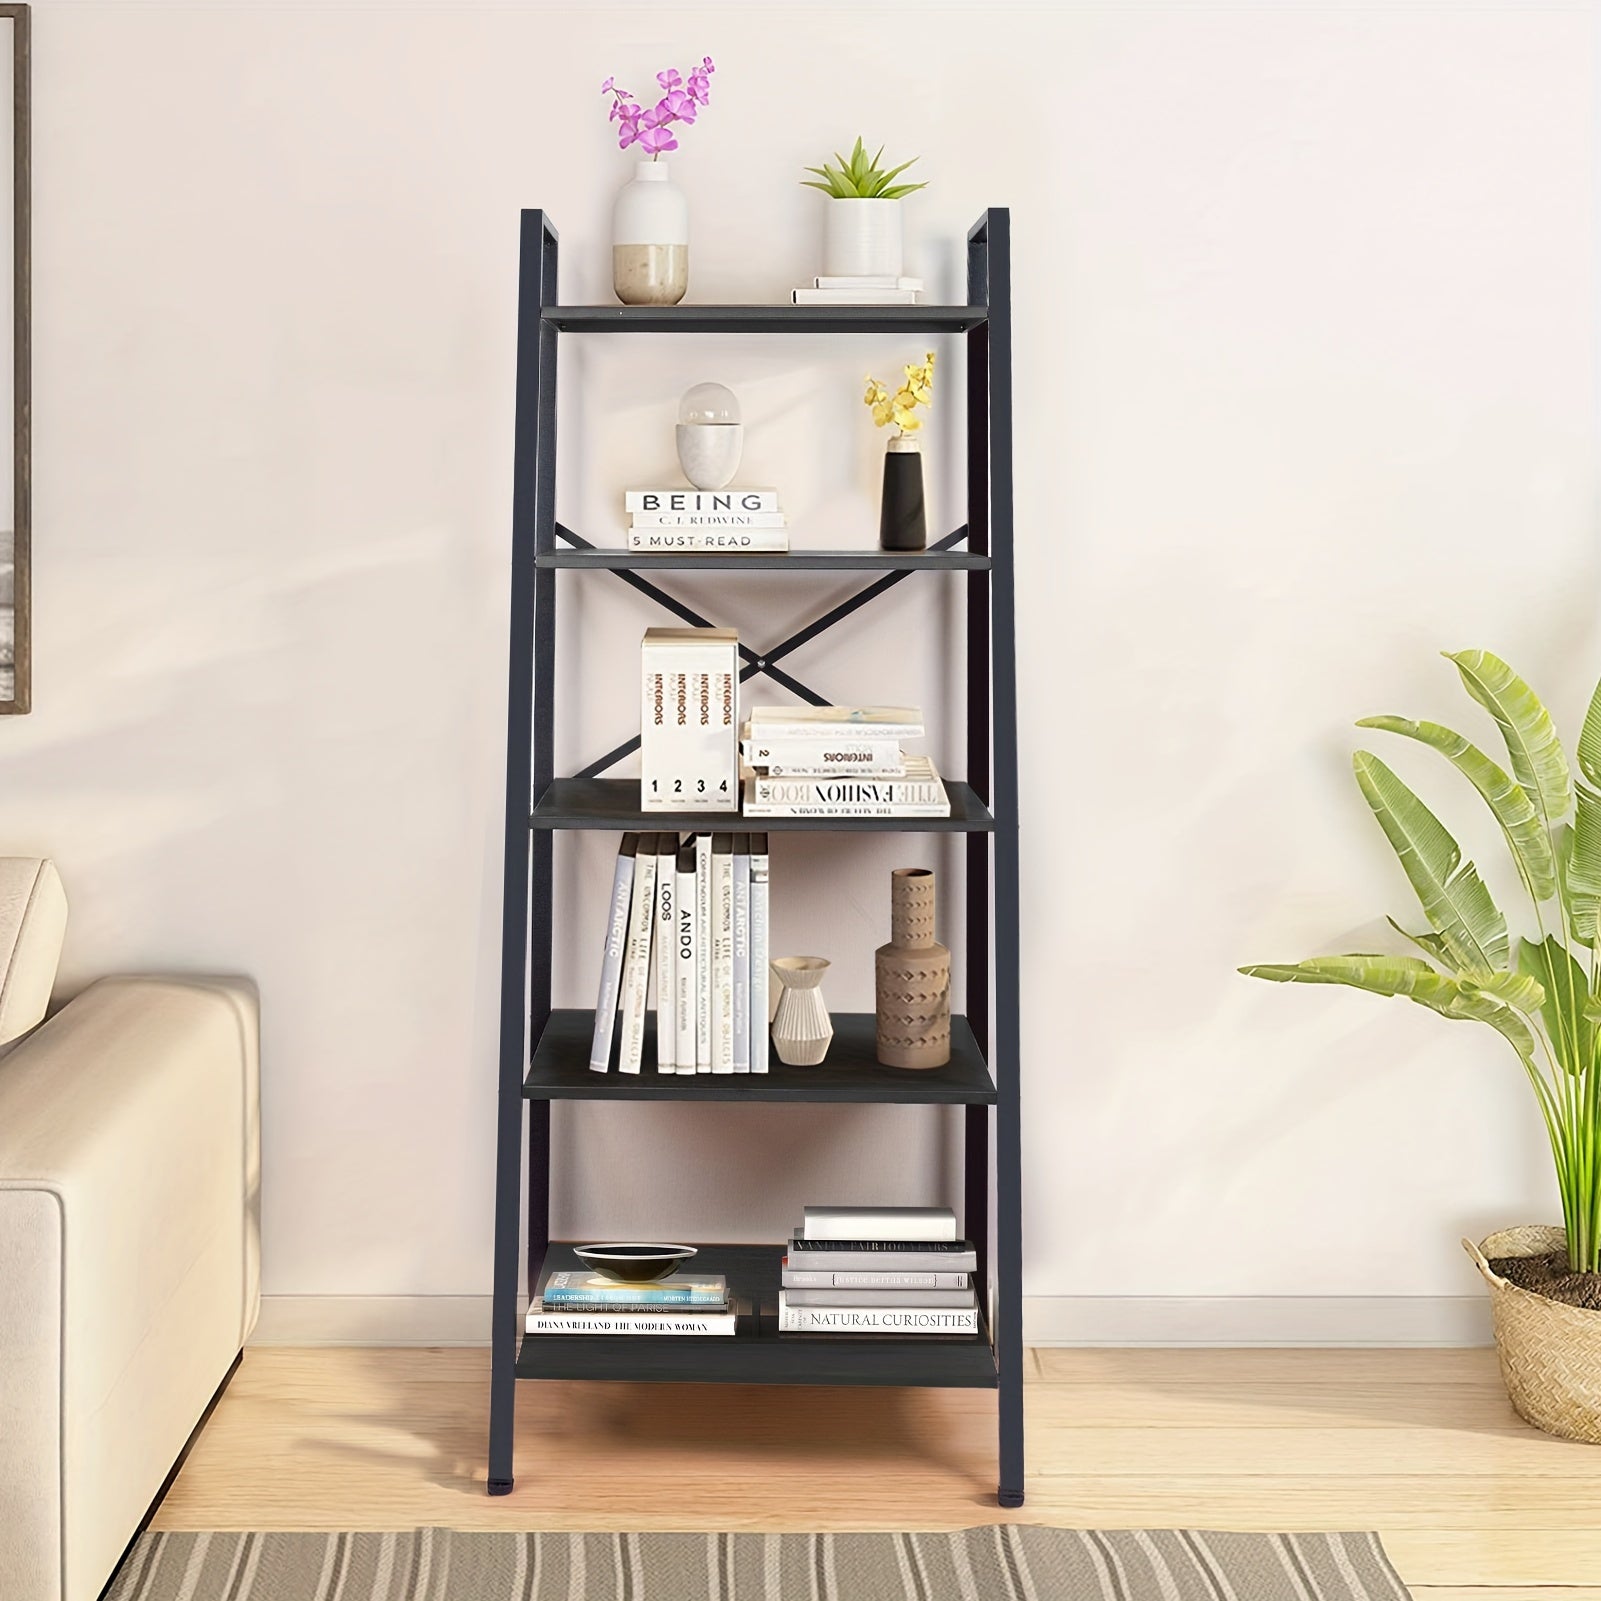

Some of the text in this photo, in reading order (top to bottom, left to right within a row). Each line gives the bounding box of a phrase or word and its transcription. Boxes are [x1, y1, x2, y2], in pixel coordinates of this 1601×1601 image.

[642, 494, 762, 511] BEING
[659, 516, 671, 525] C.
[690, 516, 753, 525] REDWINE
[633, 536, 751, 546] 5 MUST-READ
[654, 673, 663, 726] INTERIORS
[677, 673, 686, 726] INTERIORS
[700, 673, 709, 726] INTERIORS
[723, 673, 732, 726] INTERIORS
[759, 749, 770, 757] 2
[823, 753, 873, 762] INTERIORS
[651, 779, 658, 793] 1
[674, 779, 682, 793] 2
[697, 779, 705, 793] 3
[719, 779, 728, 793] 4
[815, 784, 893, 802] FASHION
[898, 782, 937, 802] THE
[645, 864, 654, 879] THE
[722, 862, 731, 878] THE
[641, 886, 651, 932] UNCOMMON
[661, 883, 672, 921] LOOS
[722, 886, 731, 932] UNCOMMON
[735, 881, 746, 958] ANTARCTIC
[680, 909, 692, 960] ANDO
[638, 938, 648, 960] LIFE
[700, 918, 708, 994] ARCHITECTURAL
[722, 937, 731, 959] LIFE
[700, 996, 708, 1045] ANTIQUES
[851, 1242, 879, 1251] FAIR
[882, 1243, 901, 1252] 100
[552, 1302, 573, 1311] THE
[576, 1303, 609, 1312] LIGHT
[613, 1303, 626, 1312] OF
[537, 1320, 708, 1332] DIANA VREELAND THE MODERN WOMAN
[811, 1313, 880, 1327] NATURAL
[882, 1314, 972, 1328] CURIOSITIES
